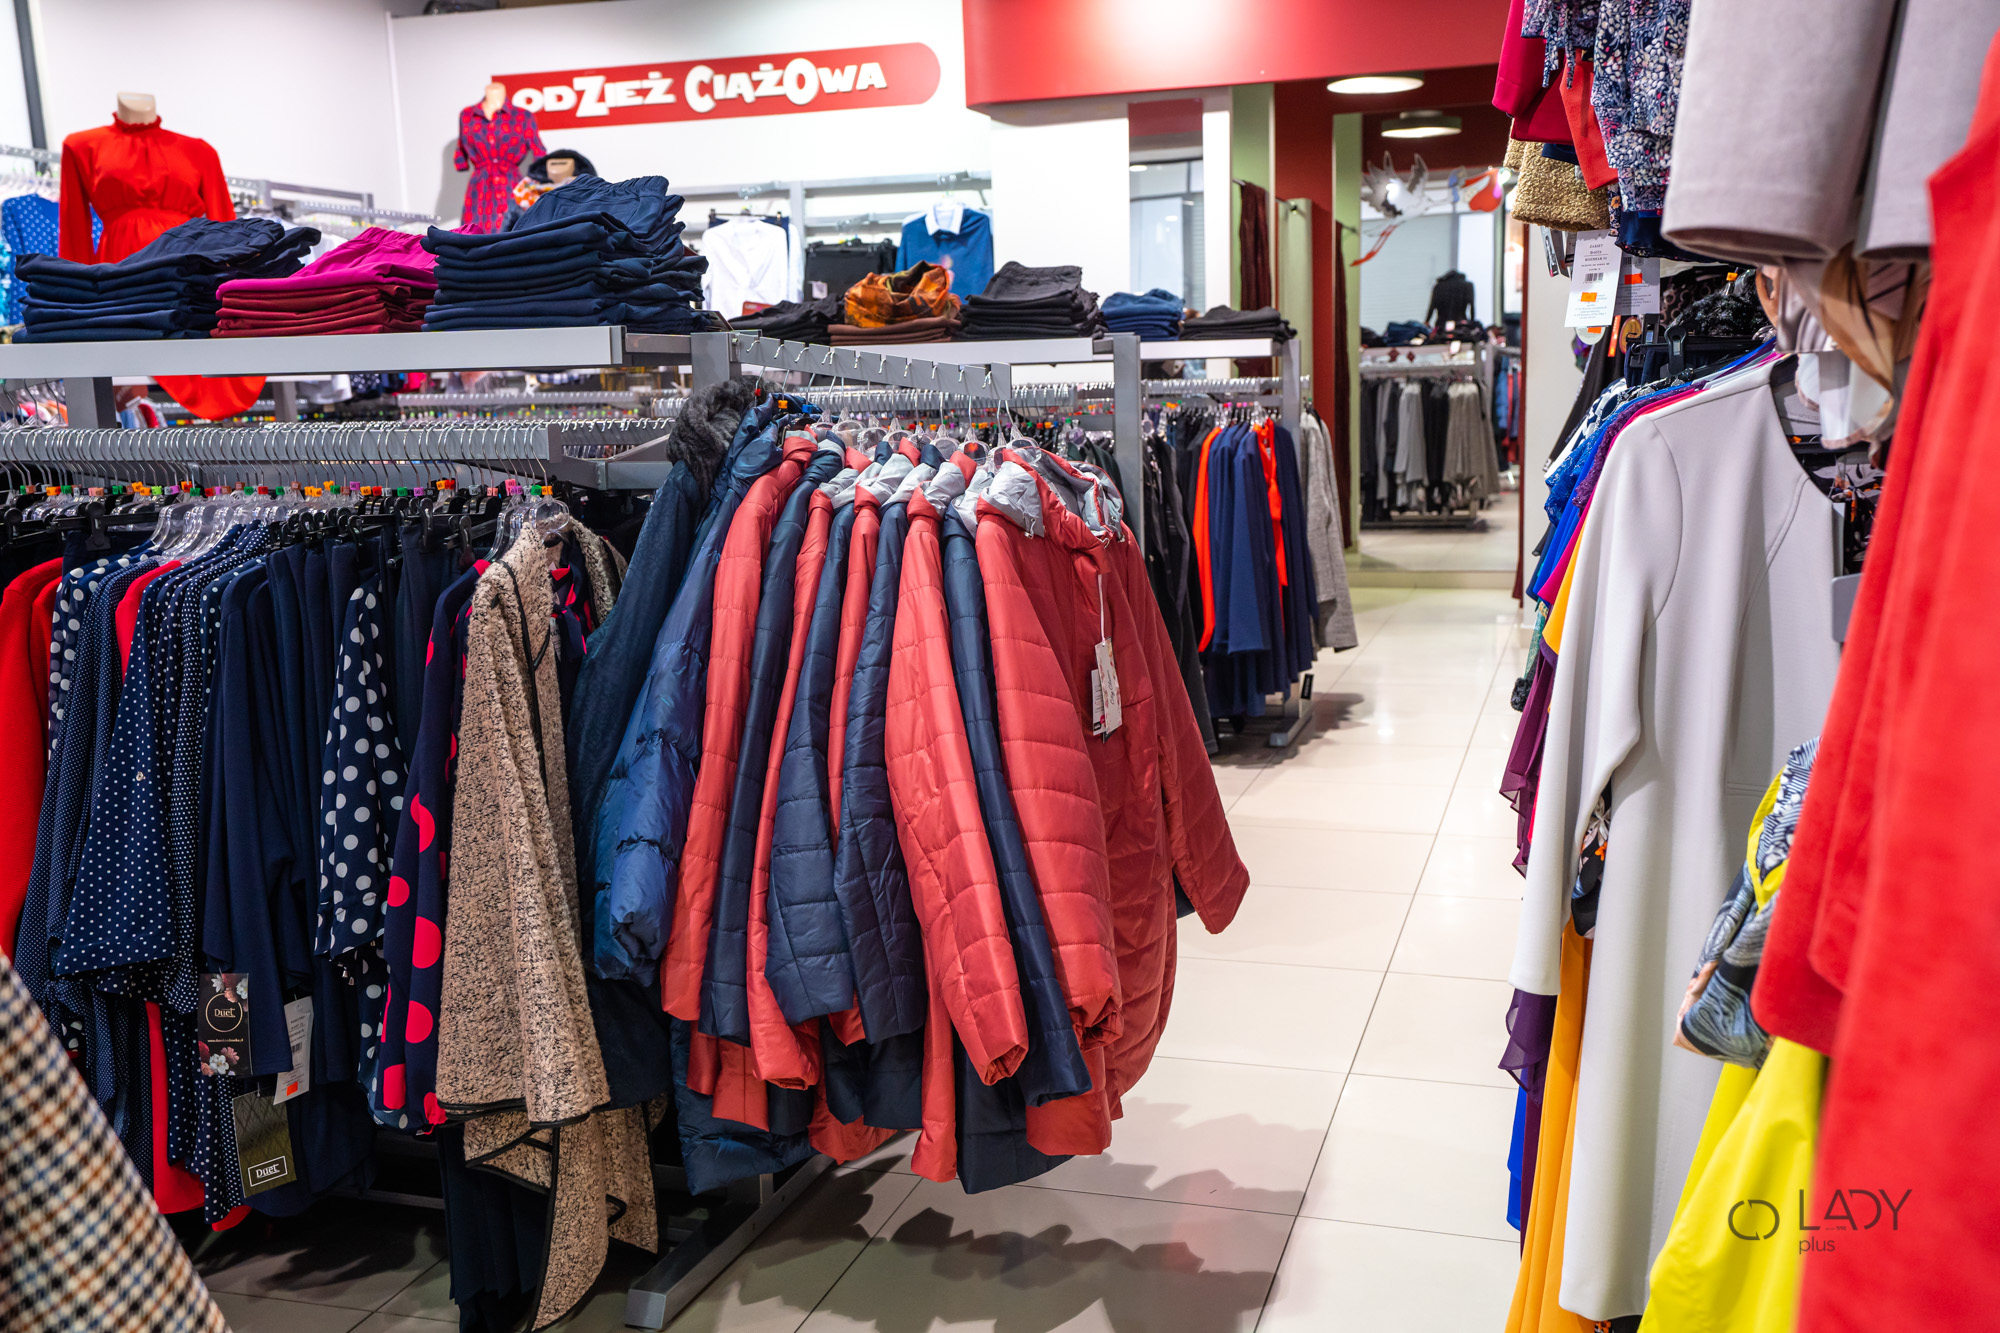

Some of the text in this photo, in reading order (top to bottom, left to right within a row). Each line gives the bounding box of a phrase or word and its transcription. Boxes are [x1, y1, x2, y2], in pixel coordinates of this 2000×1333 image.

[512, 58, 887, 118] ODZIEŻ CIĄŻOWA
[214, 1007, 236, 1017] Duet
[255, 1163, 280, 1179] Duet
